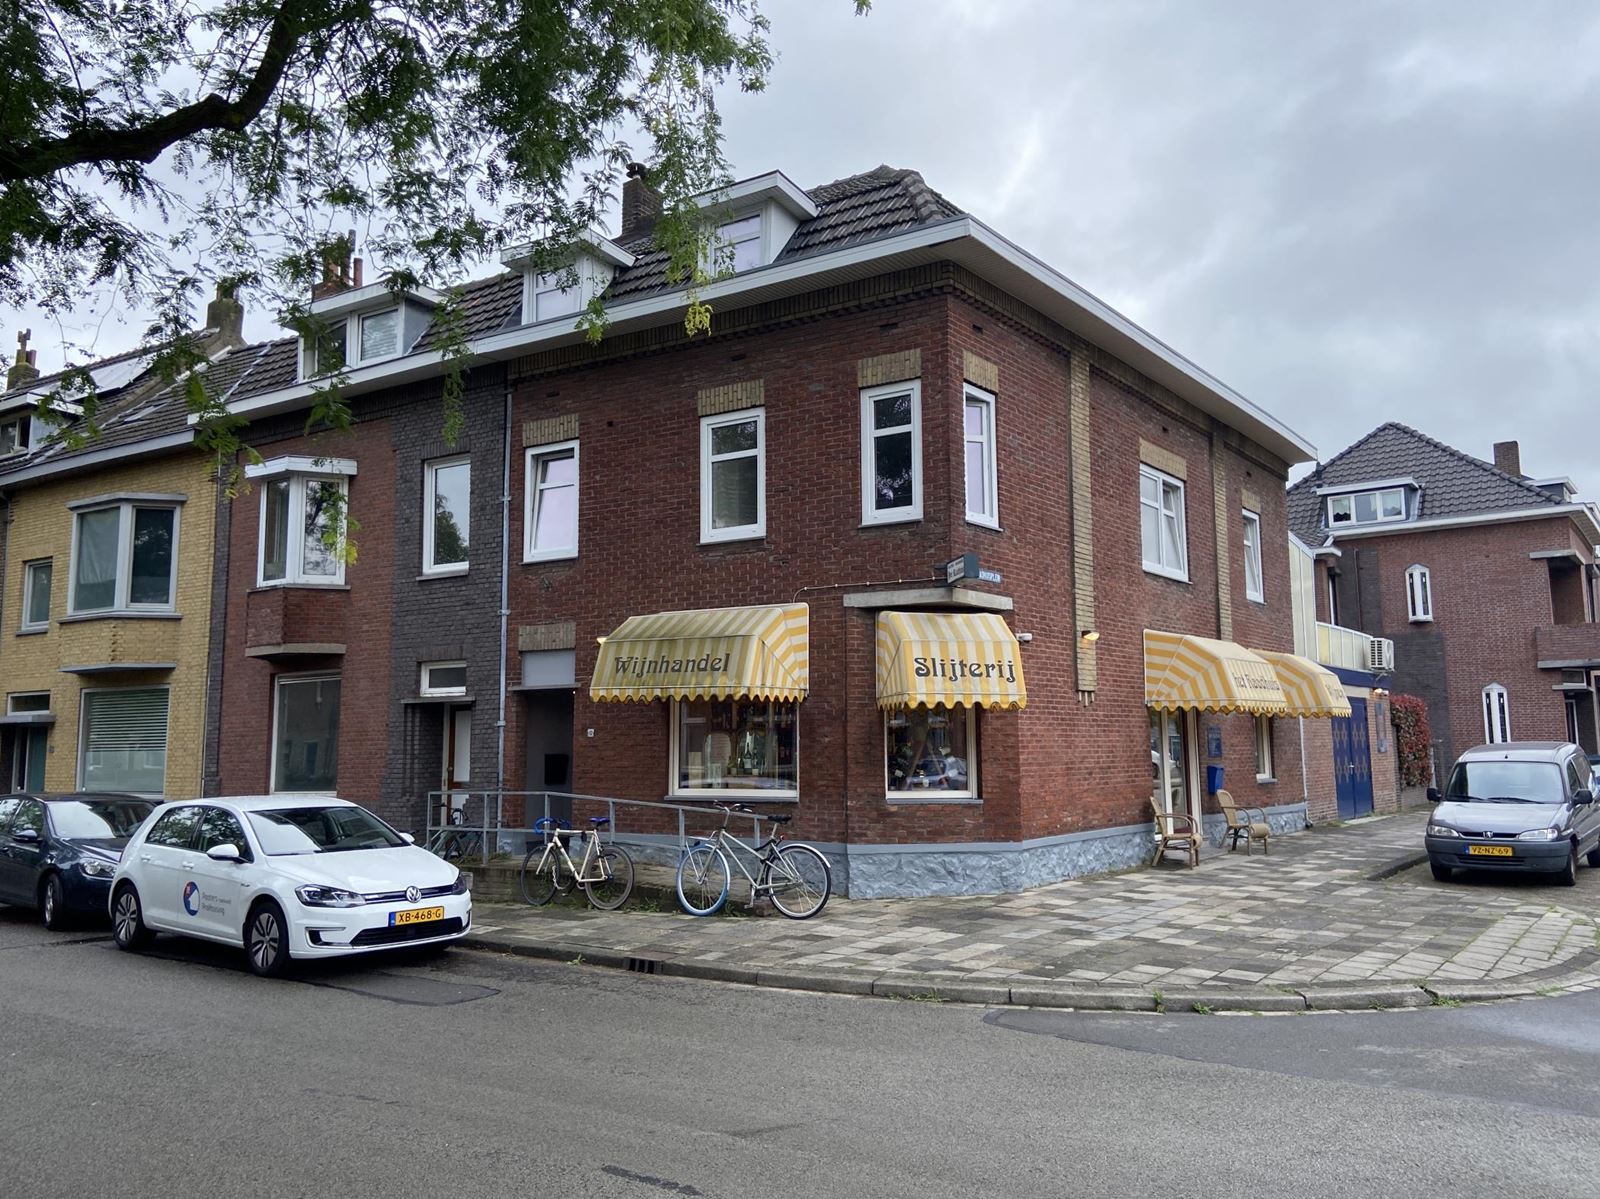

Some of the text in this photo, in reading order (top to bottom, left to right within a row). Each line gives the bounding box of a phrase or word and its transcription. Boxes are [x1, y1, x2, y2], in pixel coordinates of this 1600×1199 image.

[614, 653, 730, 678] Wijnhandel
[914, 657, 1016, 683] Slijterij
[398, 908, 442, 923] XB-468-G
